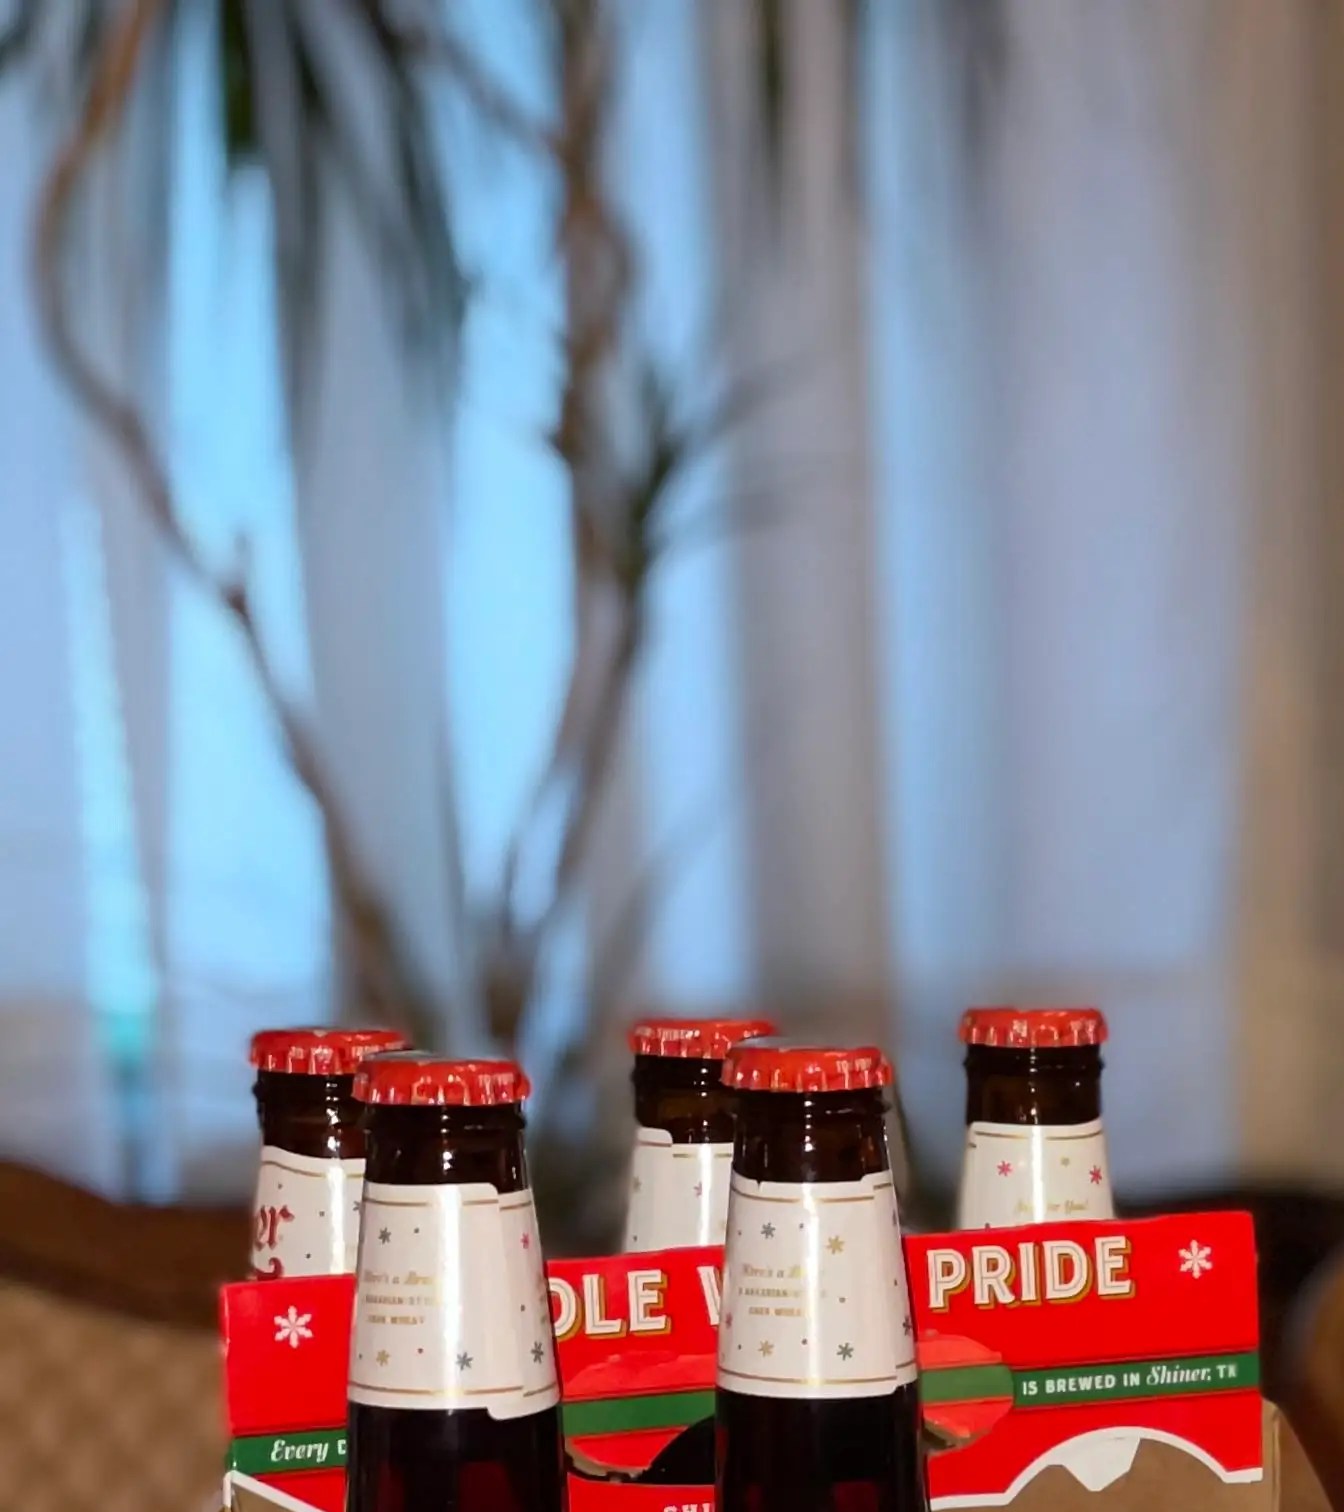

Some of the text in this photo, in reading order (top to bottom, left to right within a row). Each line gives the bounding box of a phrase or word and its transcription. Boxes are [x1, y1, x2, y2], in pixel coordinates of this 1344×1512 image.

[926, 1234, 1137, 1314] PRIDE
[1022, 1381, 1037, 1395] IS
[1045, 1374, 1116, 1394] BREWED
[1123, 1372, 1140, 1387] IN
[1146, 1365, 1211, 1386] Shiner,
[270, 1439, 329, 1463] Every
